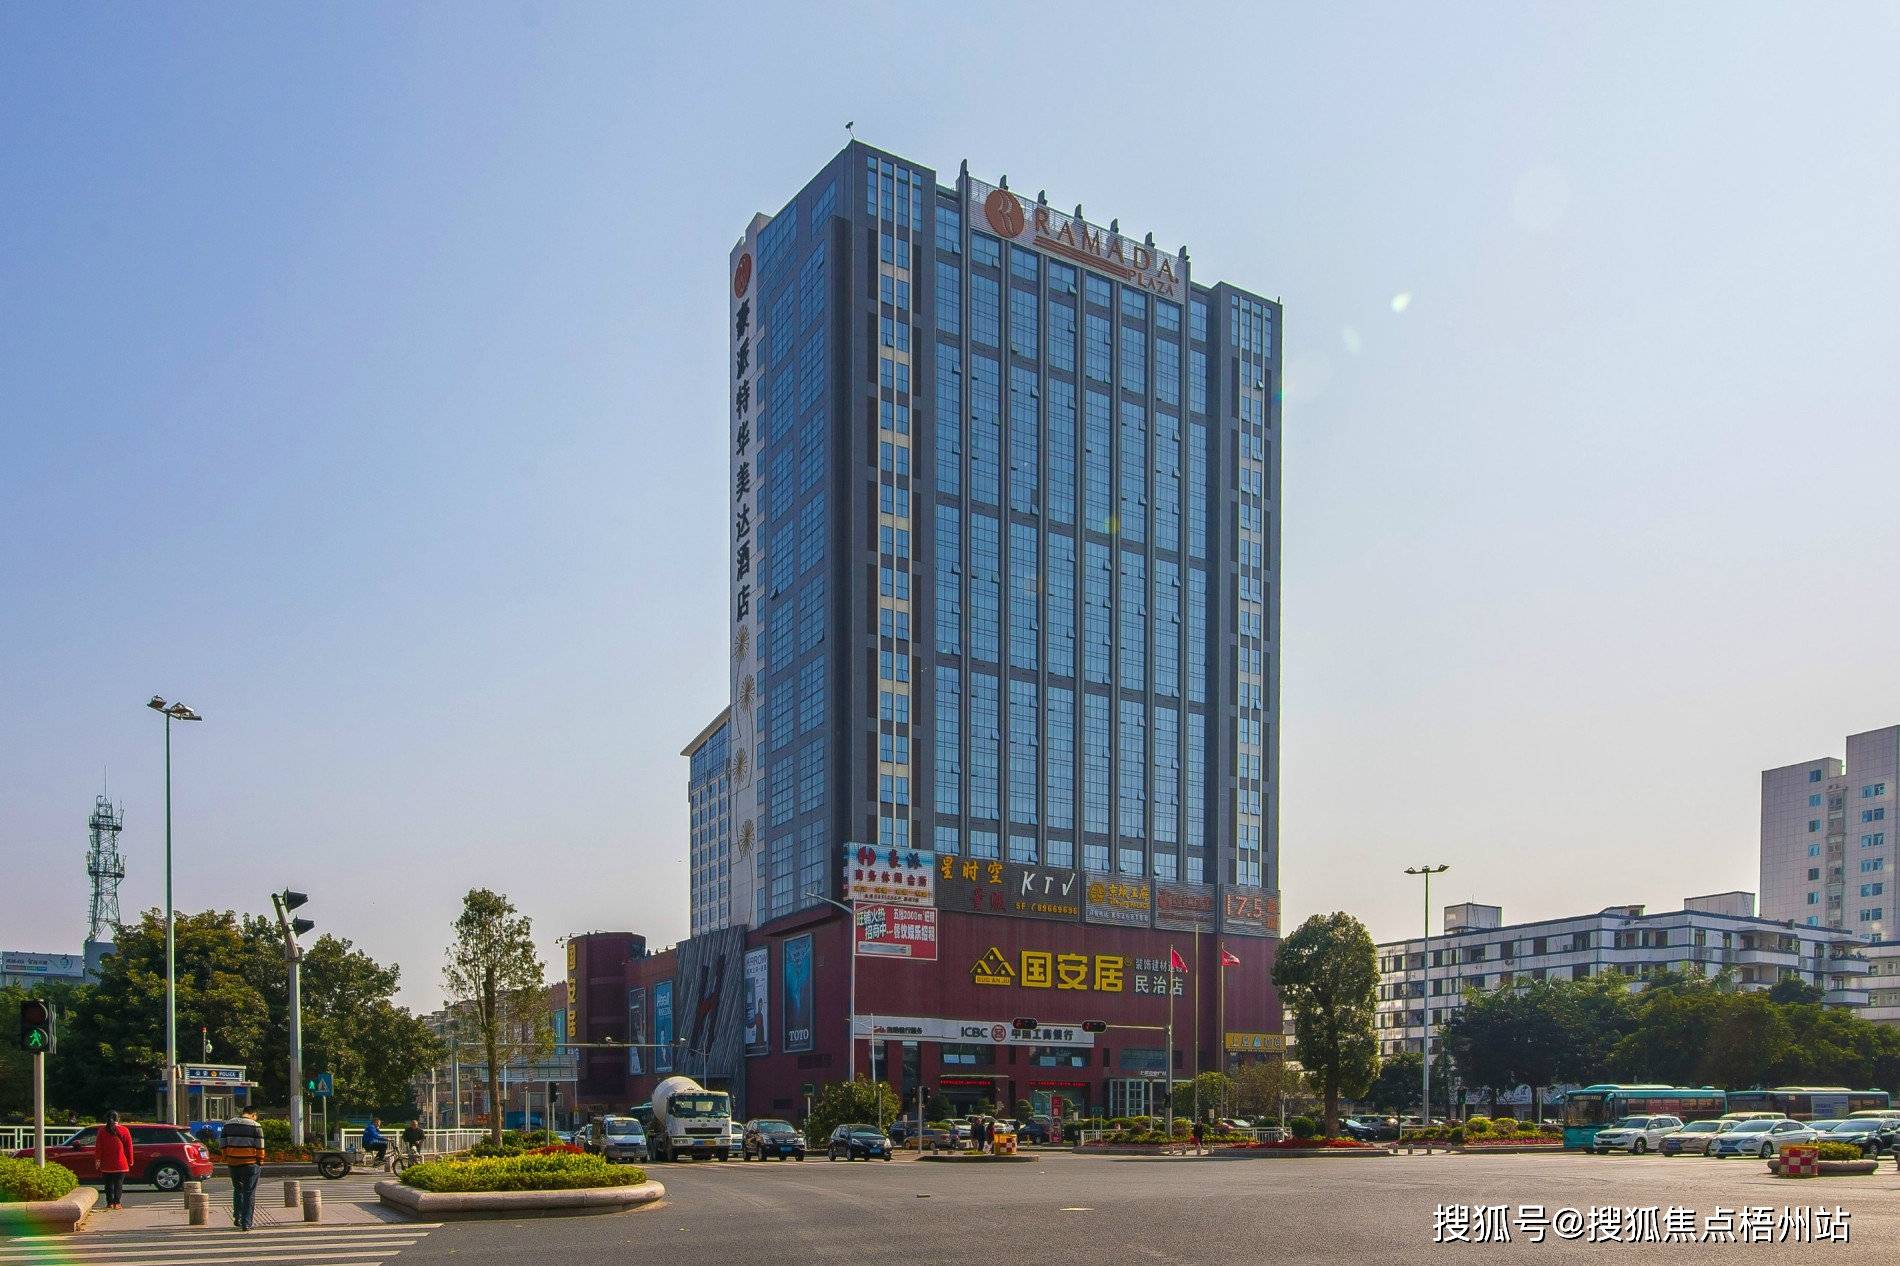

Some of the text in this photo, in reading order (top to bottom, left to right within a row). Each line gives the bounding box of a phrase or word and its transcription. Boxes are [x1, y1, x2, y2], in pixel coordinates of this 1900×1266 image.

[1034, 207, 1176, 283] RAMADA
[1127, 269, 1174, 297] PLAZA
[941, 856, 1003, 885] 星时空
[1021, 870, 1076, 897] KTV
[1225, 894, 1263, 918] 17.5
[1021, 950, 1124, 992] 国安居
[1135, 975, 1183, 996] 民治店
[789, 1029, 809, 1041] TOTO
[960, 1026, 988, 1038] ICBC
[1011, 1029, 1074, 1041] 中国工商银行
